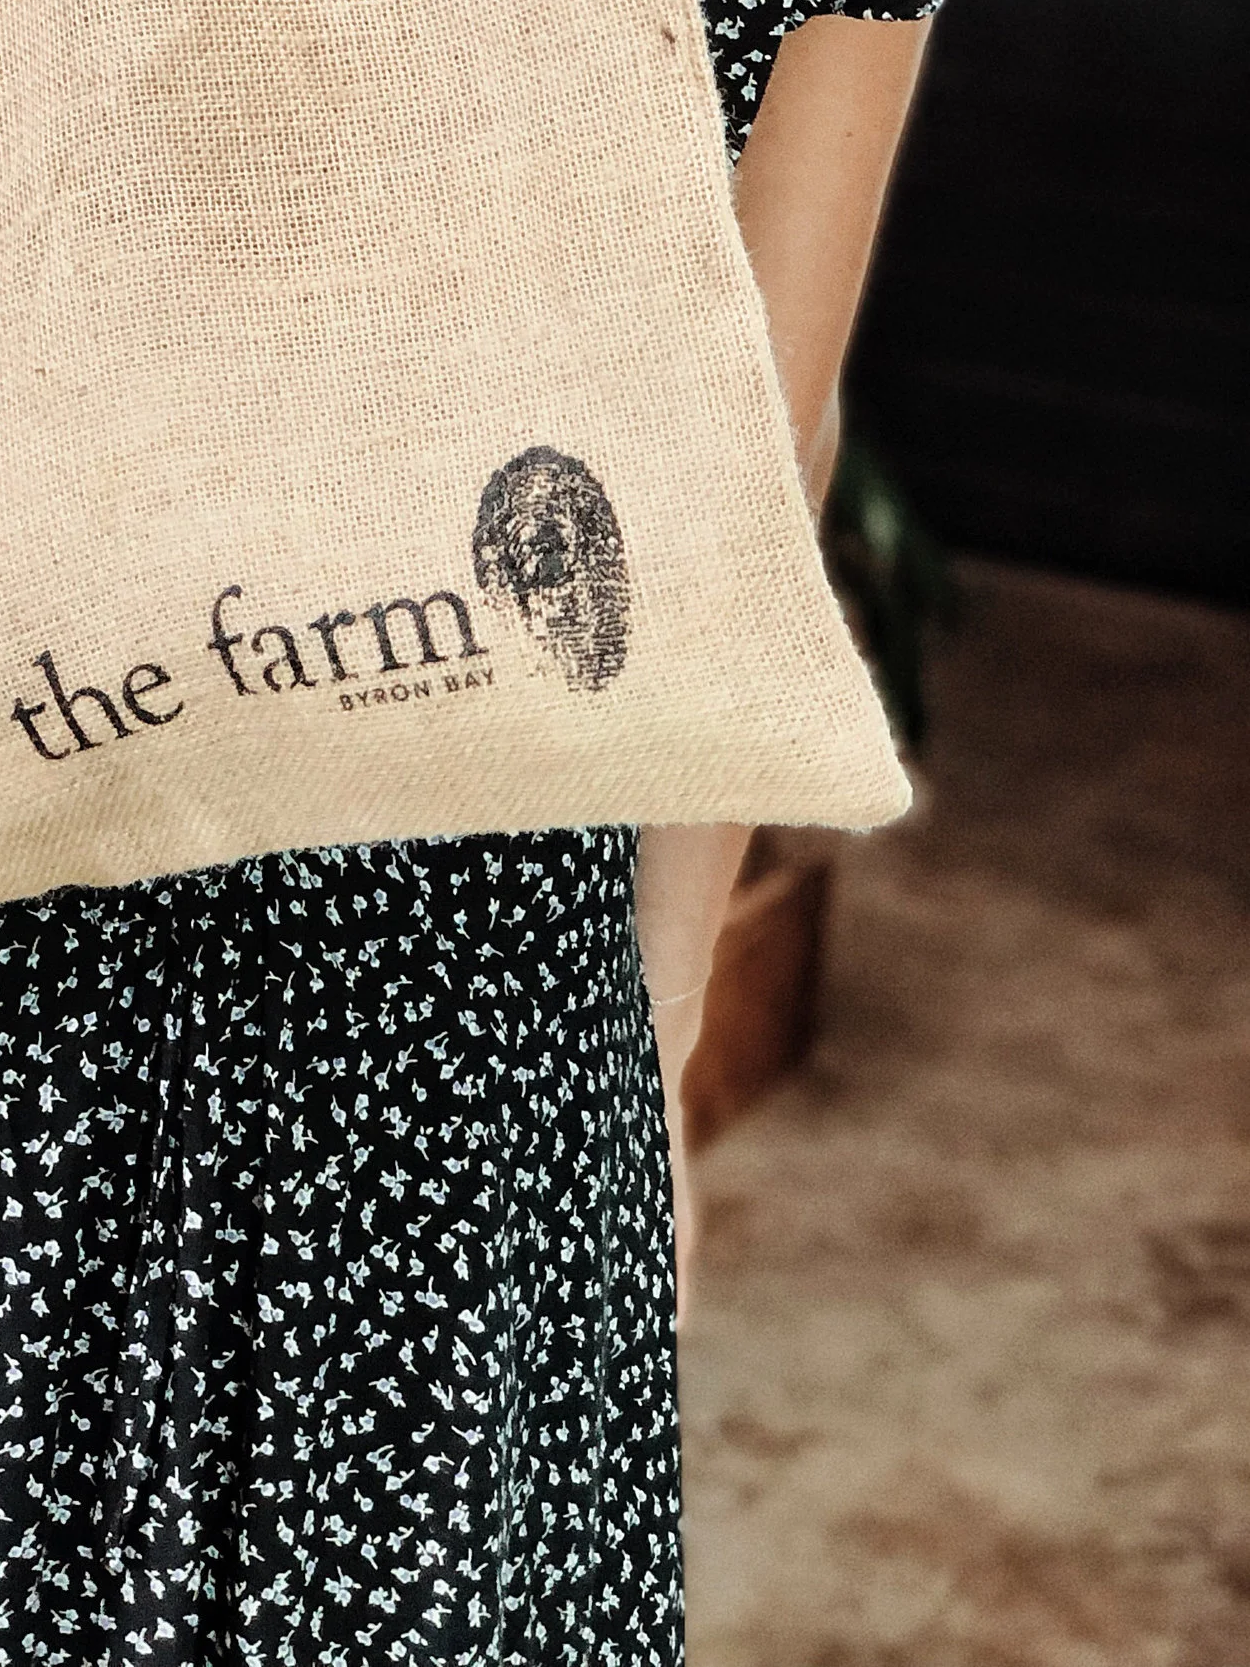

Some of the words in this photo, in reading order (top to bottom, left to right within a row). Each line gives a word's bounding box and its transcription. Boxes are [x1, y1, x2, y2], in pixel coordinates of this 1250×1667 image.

[11, 650, 184, 761] the
[208, 584, 488, 696] farm
[338, 679, 432, 712] BYRON
[445, 667, 496, 694] BAY
